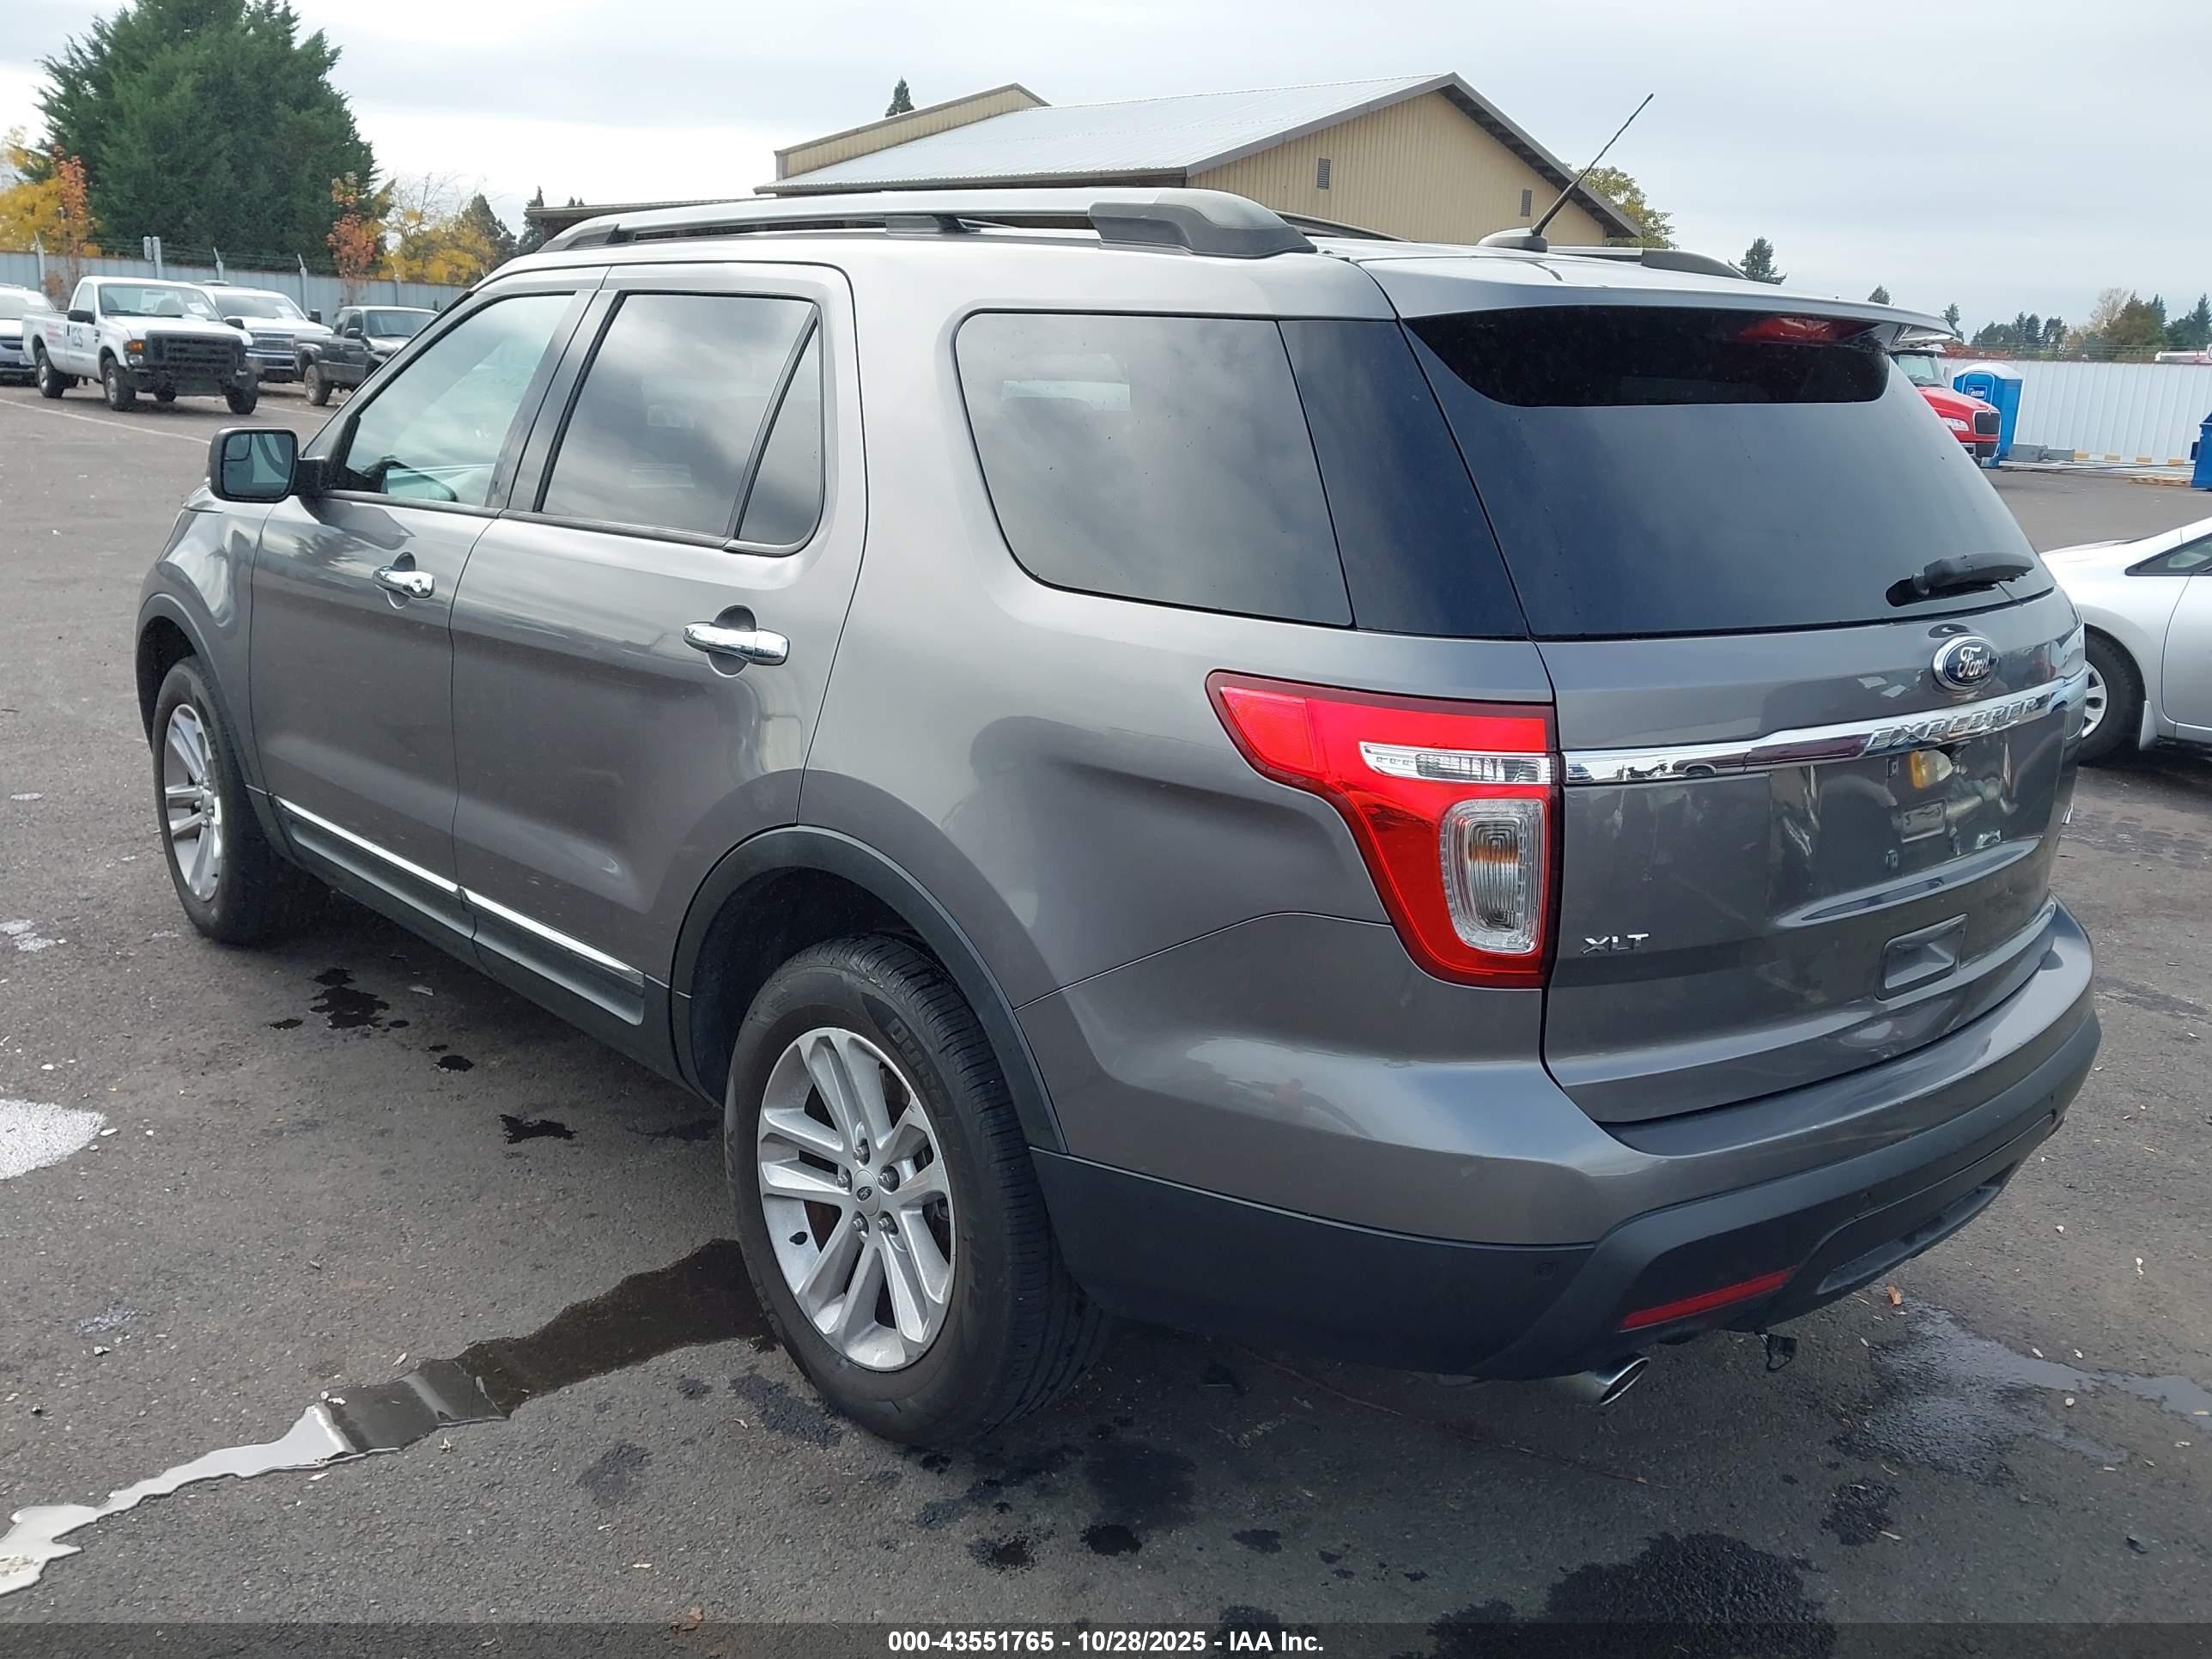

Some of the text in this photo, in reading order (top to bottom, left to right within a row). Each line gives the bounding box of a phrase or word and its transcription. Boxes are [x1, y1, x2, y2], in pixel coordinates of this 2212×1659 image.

[1958, 646, 1991, 678] Ford
[1866, 697, 2037, 750] EXPLORER
[1581, 933, 1650, 955] XLT
